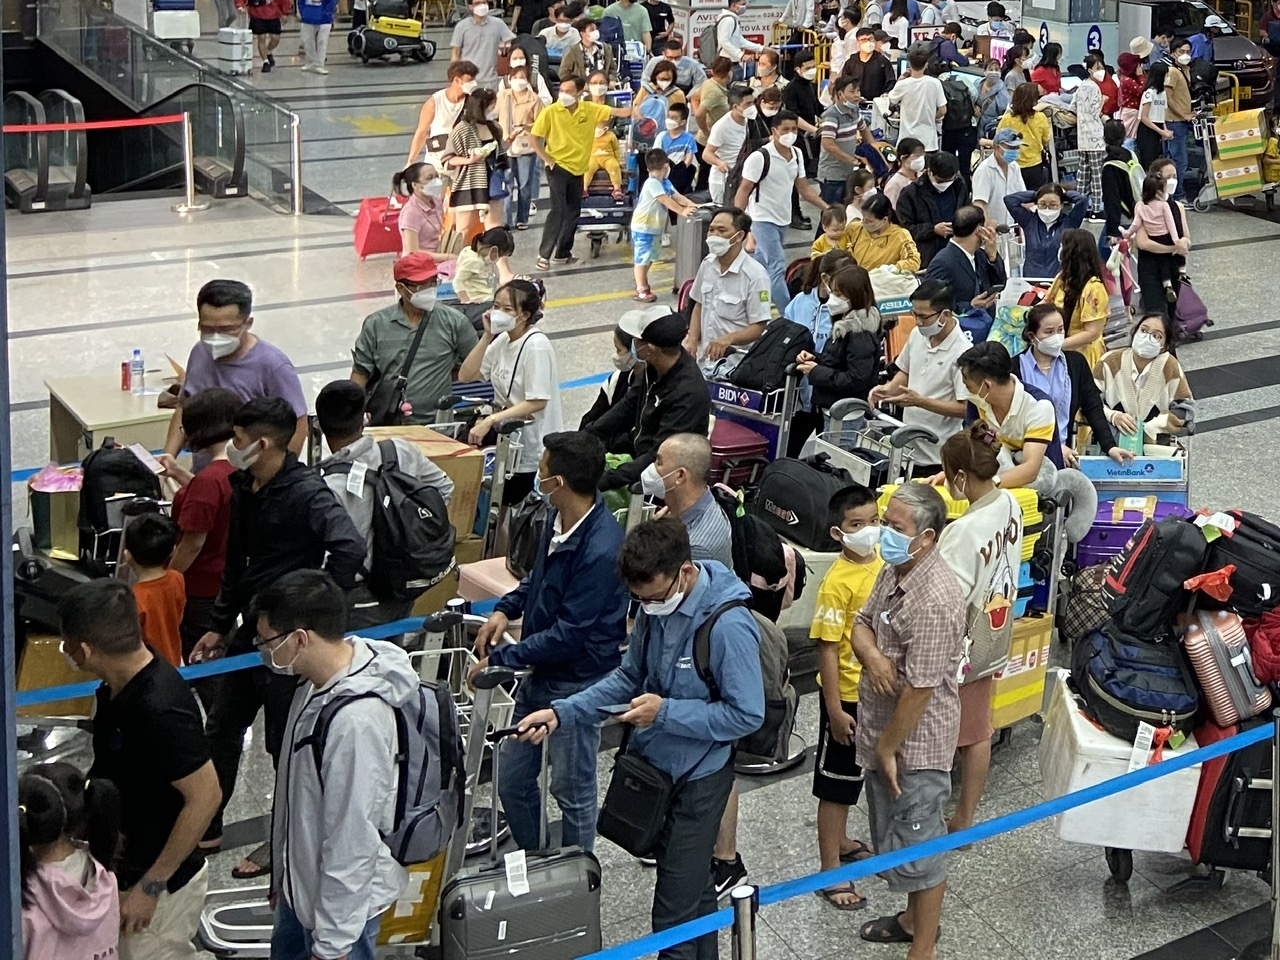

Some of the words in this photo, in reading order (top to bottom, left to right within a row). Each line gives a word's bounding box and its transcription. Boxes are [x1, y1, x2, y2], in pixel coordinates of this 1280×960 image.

[762, 24, 770, 33] XE
[1041, 28, 1047, 49] 3
[1089, 32, 1099, 51] 3
[1107, 468, 1146, 476] VietinBank
